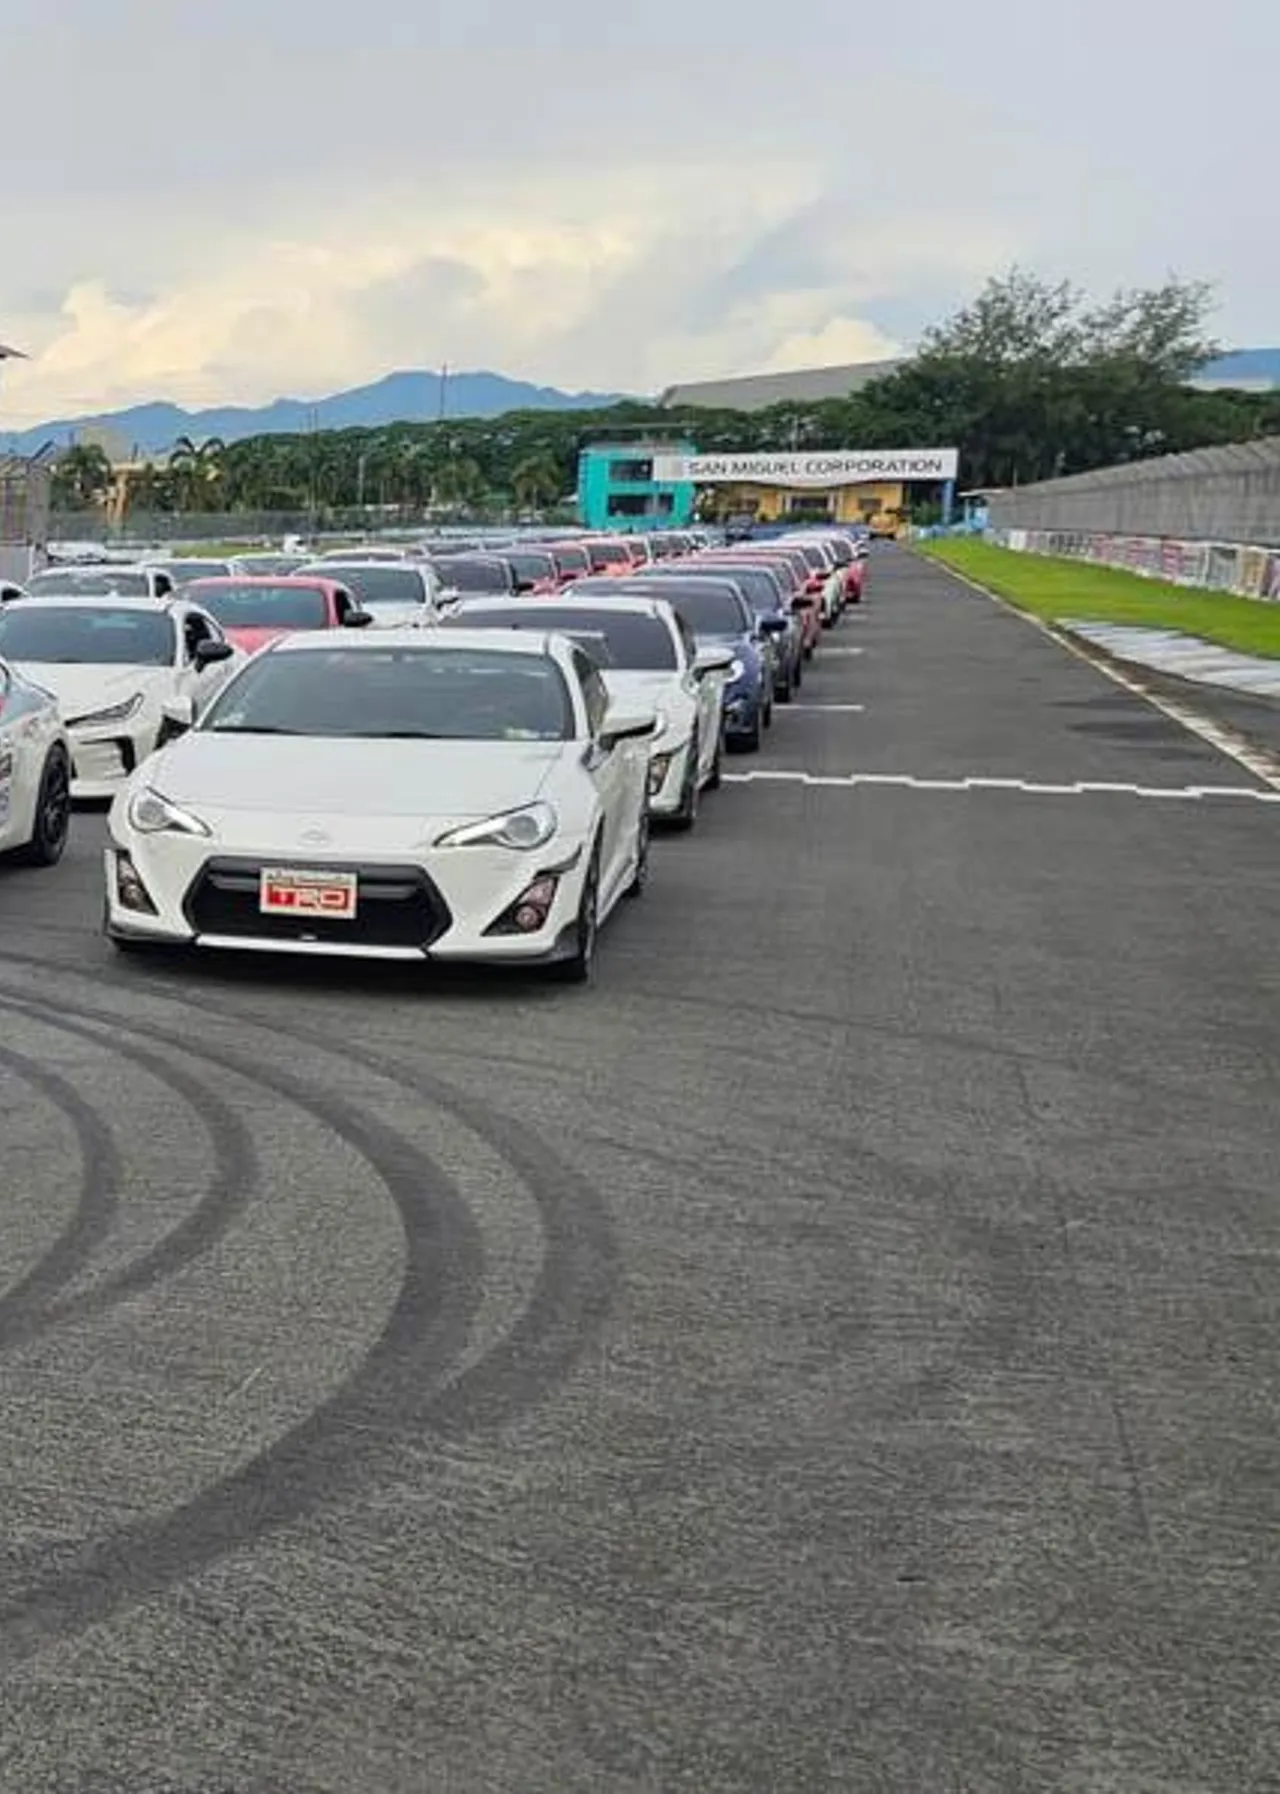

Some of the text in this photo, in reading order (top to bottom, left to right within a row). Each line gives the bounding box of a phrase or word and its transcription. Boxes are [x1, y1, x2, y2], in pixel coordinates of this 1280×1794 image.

[689, 457, 943, 475] SAN MIGUEL CORPORATION
[270, 886, 346, 909] TRD
